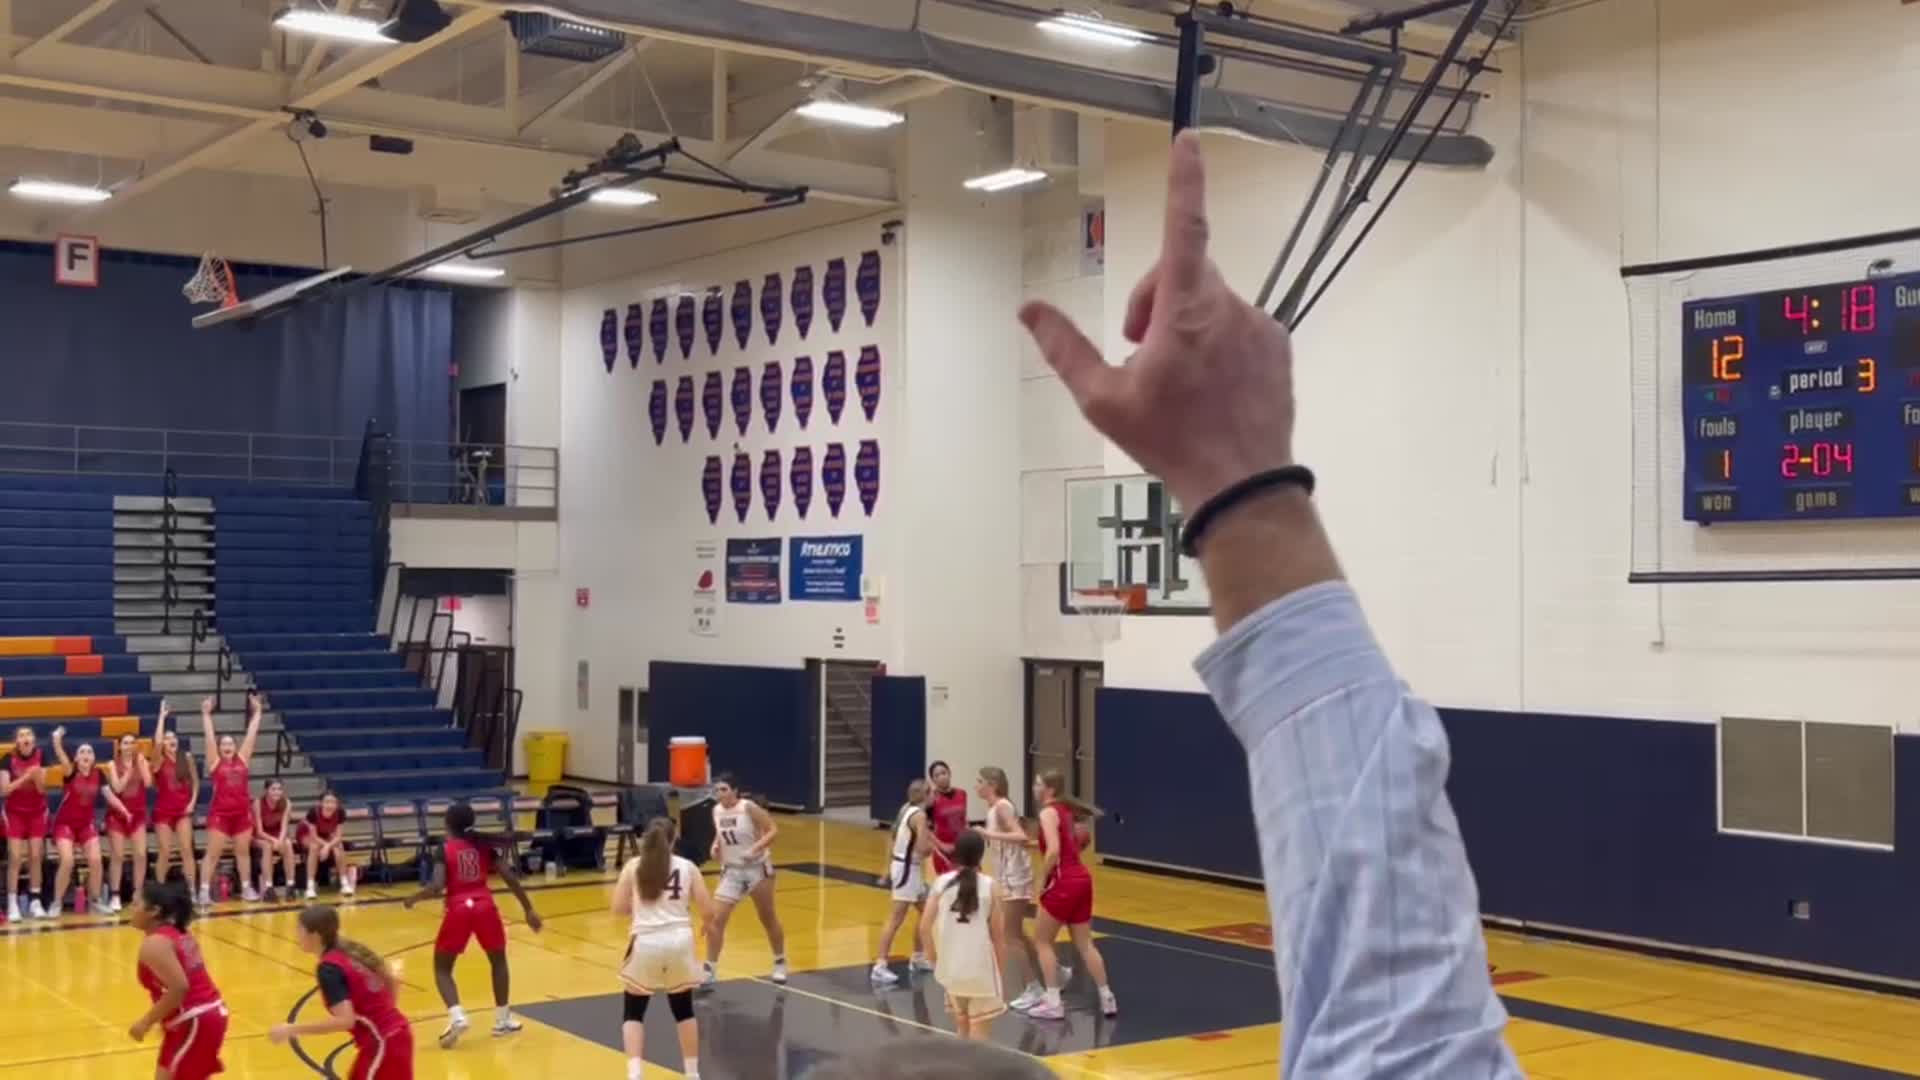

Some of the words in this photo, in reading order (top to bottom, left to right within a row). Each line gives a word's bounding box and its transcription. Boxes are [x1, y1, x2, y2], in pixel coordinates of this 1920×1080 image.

[68, 243, 89, 270] F
[1695, 309, 1736, 328] Home
[1784, 285, 1875, 334] 4:18
[1712, 335, 1743, 380] 12
[1790, 366, 1842, 393] period
[1858, 358, 1875, 391] 3
[1700, 418, 1736, 437] fouls
[1790, 409, 1842, 433] player
[1723, 449, 1731, 478] 1
[1781, 443, 1852, 477] 2-04
[1703, 495, 1731, 510] won
[1796, 491, 1837, 511] game
[722, 830, 739, 846] 11
